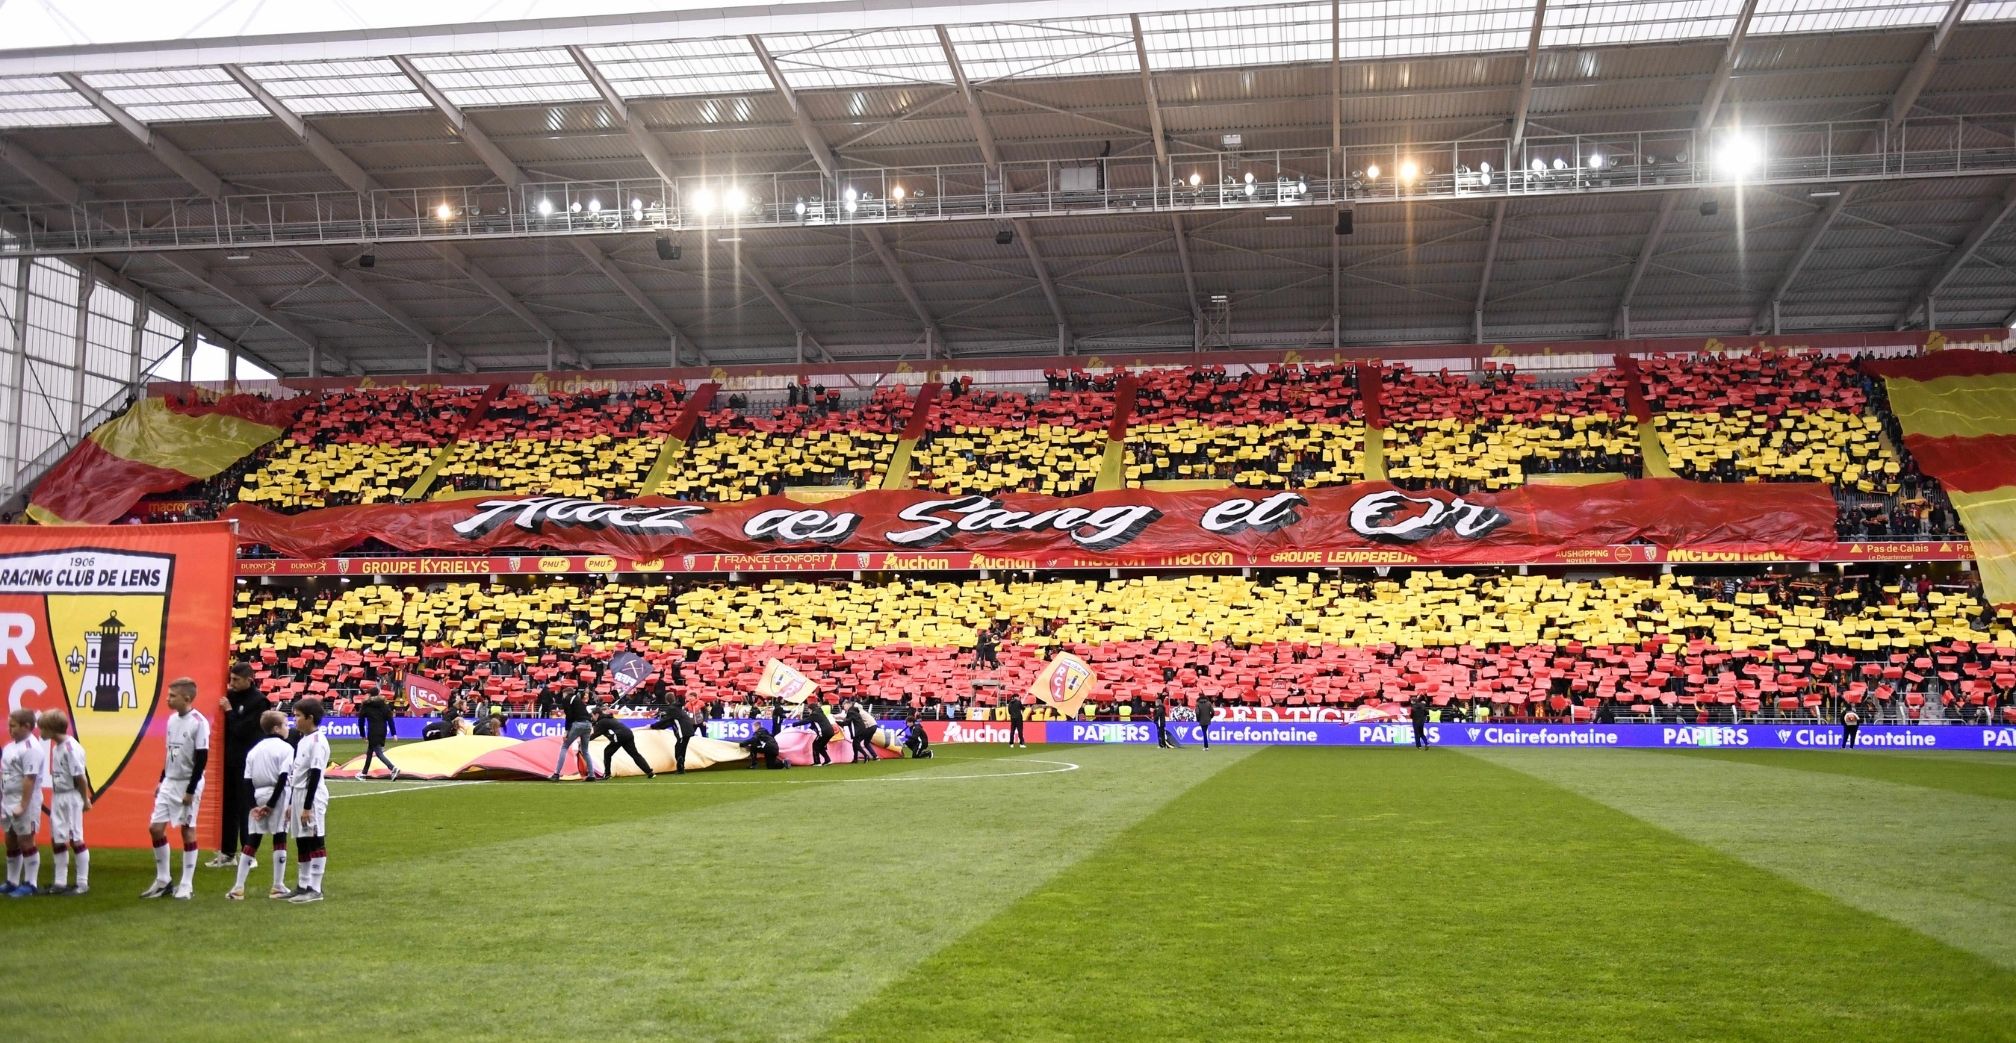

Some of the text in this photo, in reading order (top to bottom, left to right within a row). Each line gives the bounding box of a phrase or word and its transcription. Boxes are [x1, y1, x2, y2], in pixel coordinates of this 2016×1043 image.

[744, 507, 857, 540] ces
[885, 495, 1156, 544] Sang
[1201, 492, 1302, 531] et
[1350, 490, 1500, 535] Or
[70, 557, 95, 567] 1906
[542, 560, 560, 568] PMU
[725, 554, 827, 564] FRANCE CONFORT
[883, 552, 948, 570] Auchan
[970, 553, 1036, 569] Auchan
[1270, 552, 1322, 563] GROUPE
[362, 559, 490, 574] GROUPE KYRIELYS
[0, 569, 161, 588] RACING CLUB DE LENS
[1073, 725, 1150, 741] PAPIERS
[1192, 725, 1318, 742] Cairefontaine
[1359, 726, 1441, 743] PAPIES
[1484, 727, 1618, 745] Clairefontaine
[1663, 728, 1750, 745] PAPIERS
[1795, 729, 1937, 746] Clairfontaine
